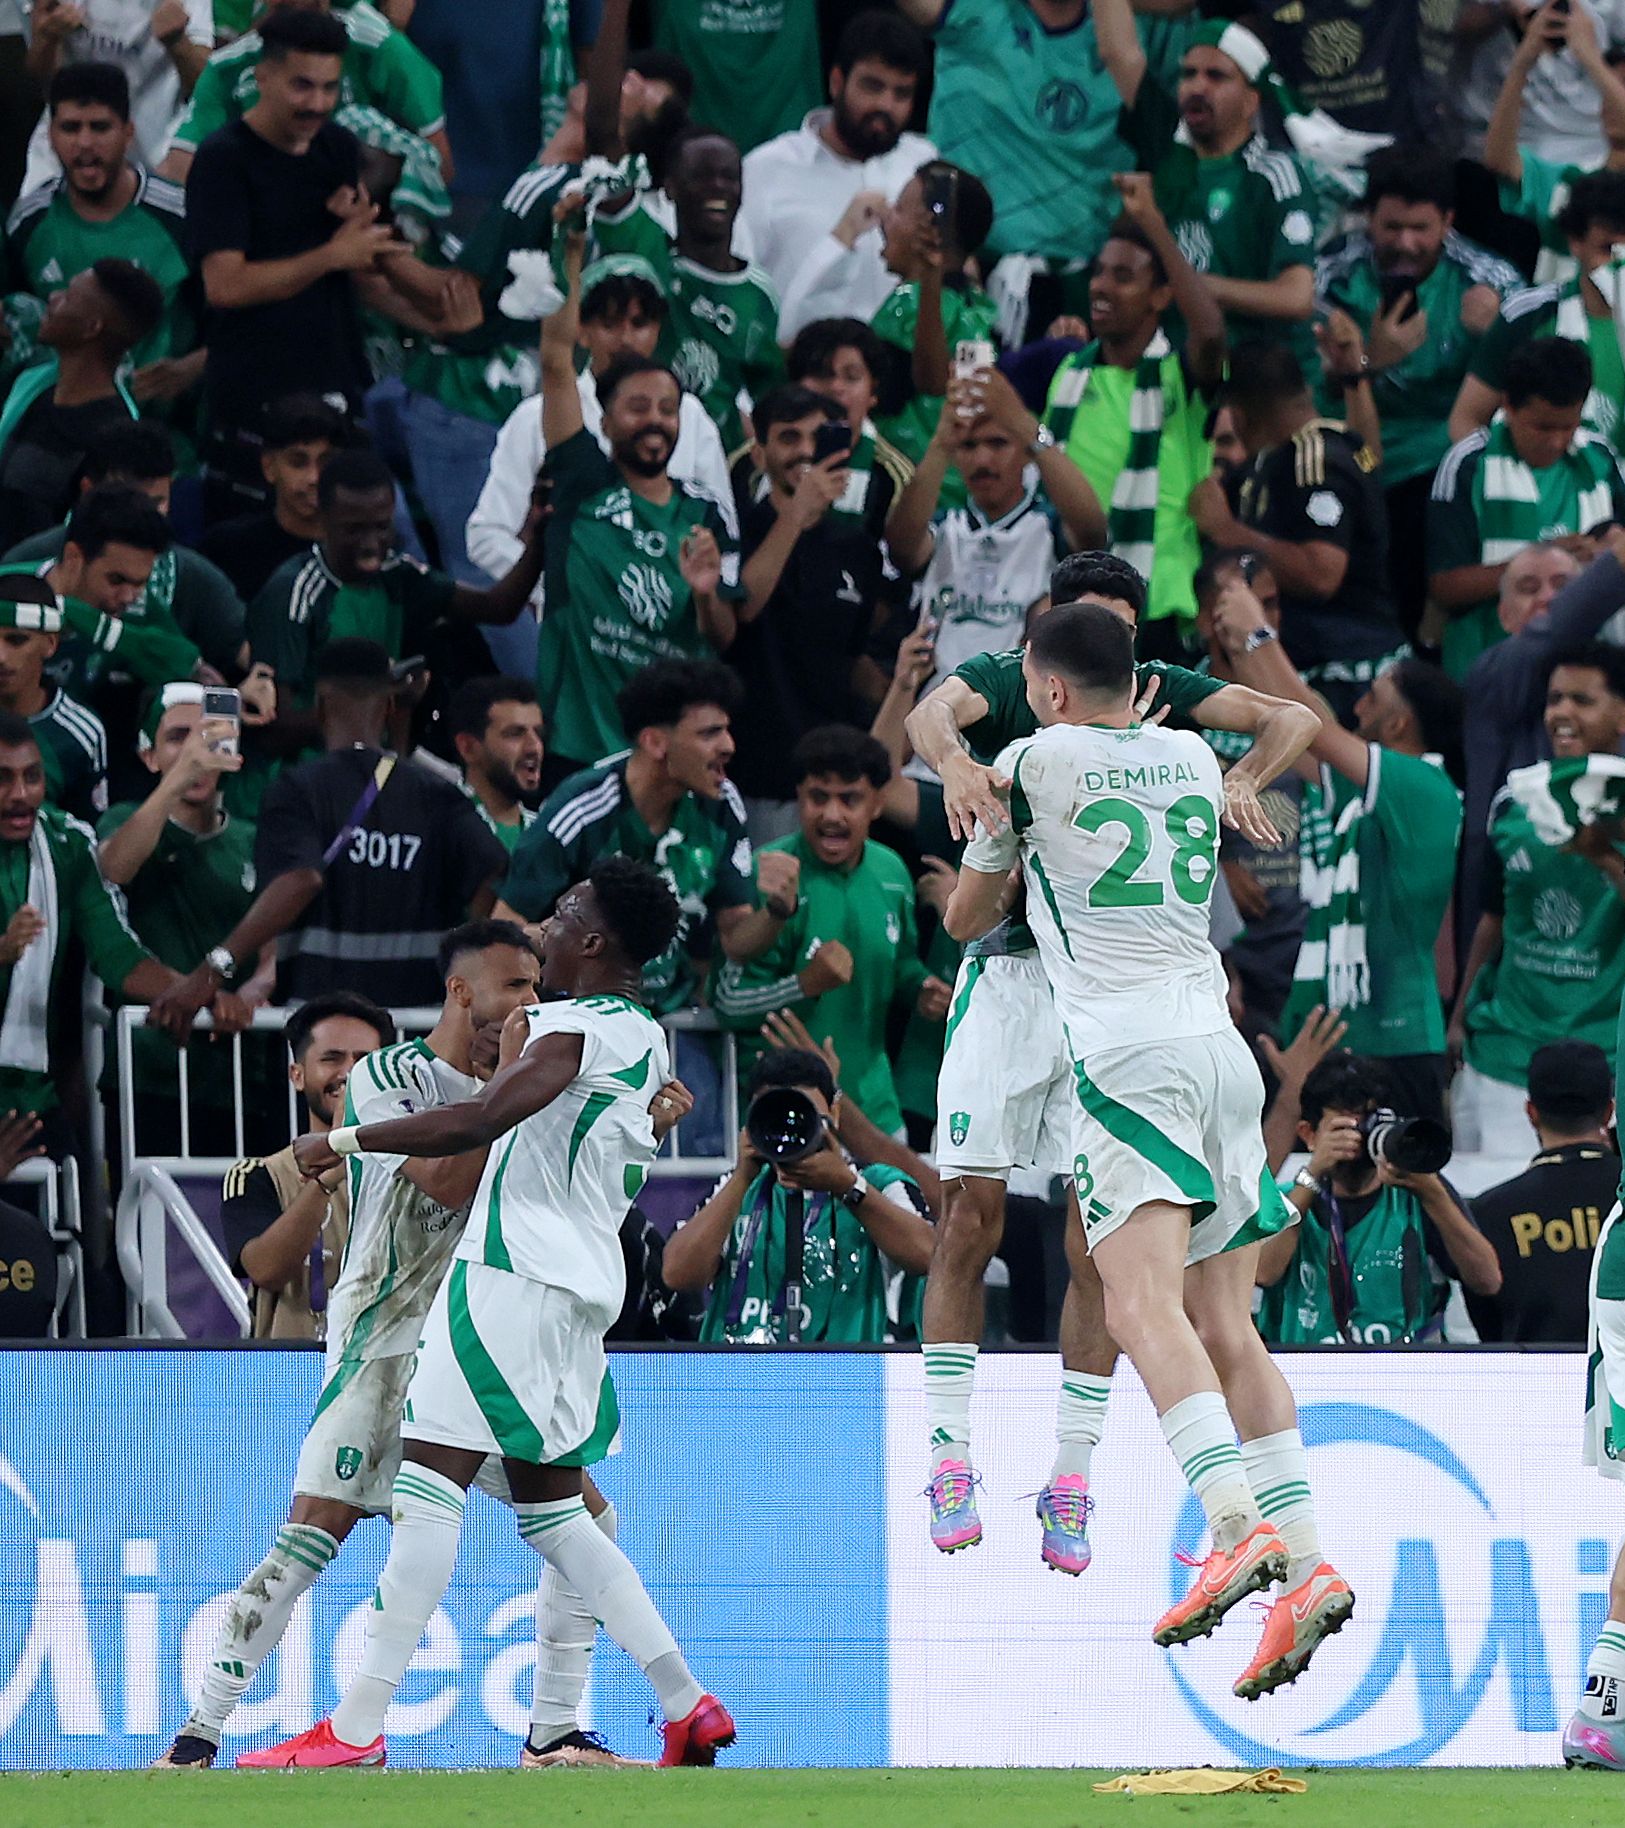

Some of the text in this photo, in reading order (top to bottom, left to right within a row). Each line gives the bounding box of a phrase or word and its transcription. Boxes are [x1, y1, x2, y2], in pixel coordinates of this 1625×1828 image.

[1084, 762, 1200, 792] DEMIRAL
[348, 825, 422, 871] 3017
[1071, 794, 1219, 909] 28
[1074, 1153, 1094, 1200] 8
[1510, 1206, 1600, 1258] Poli
